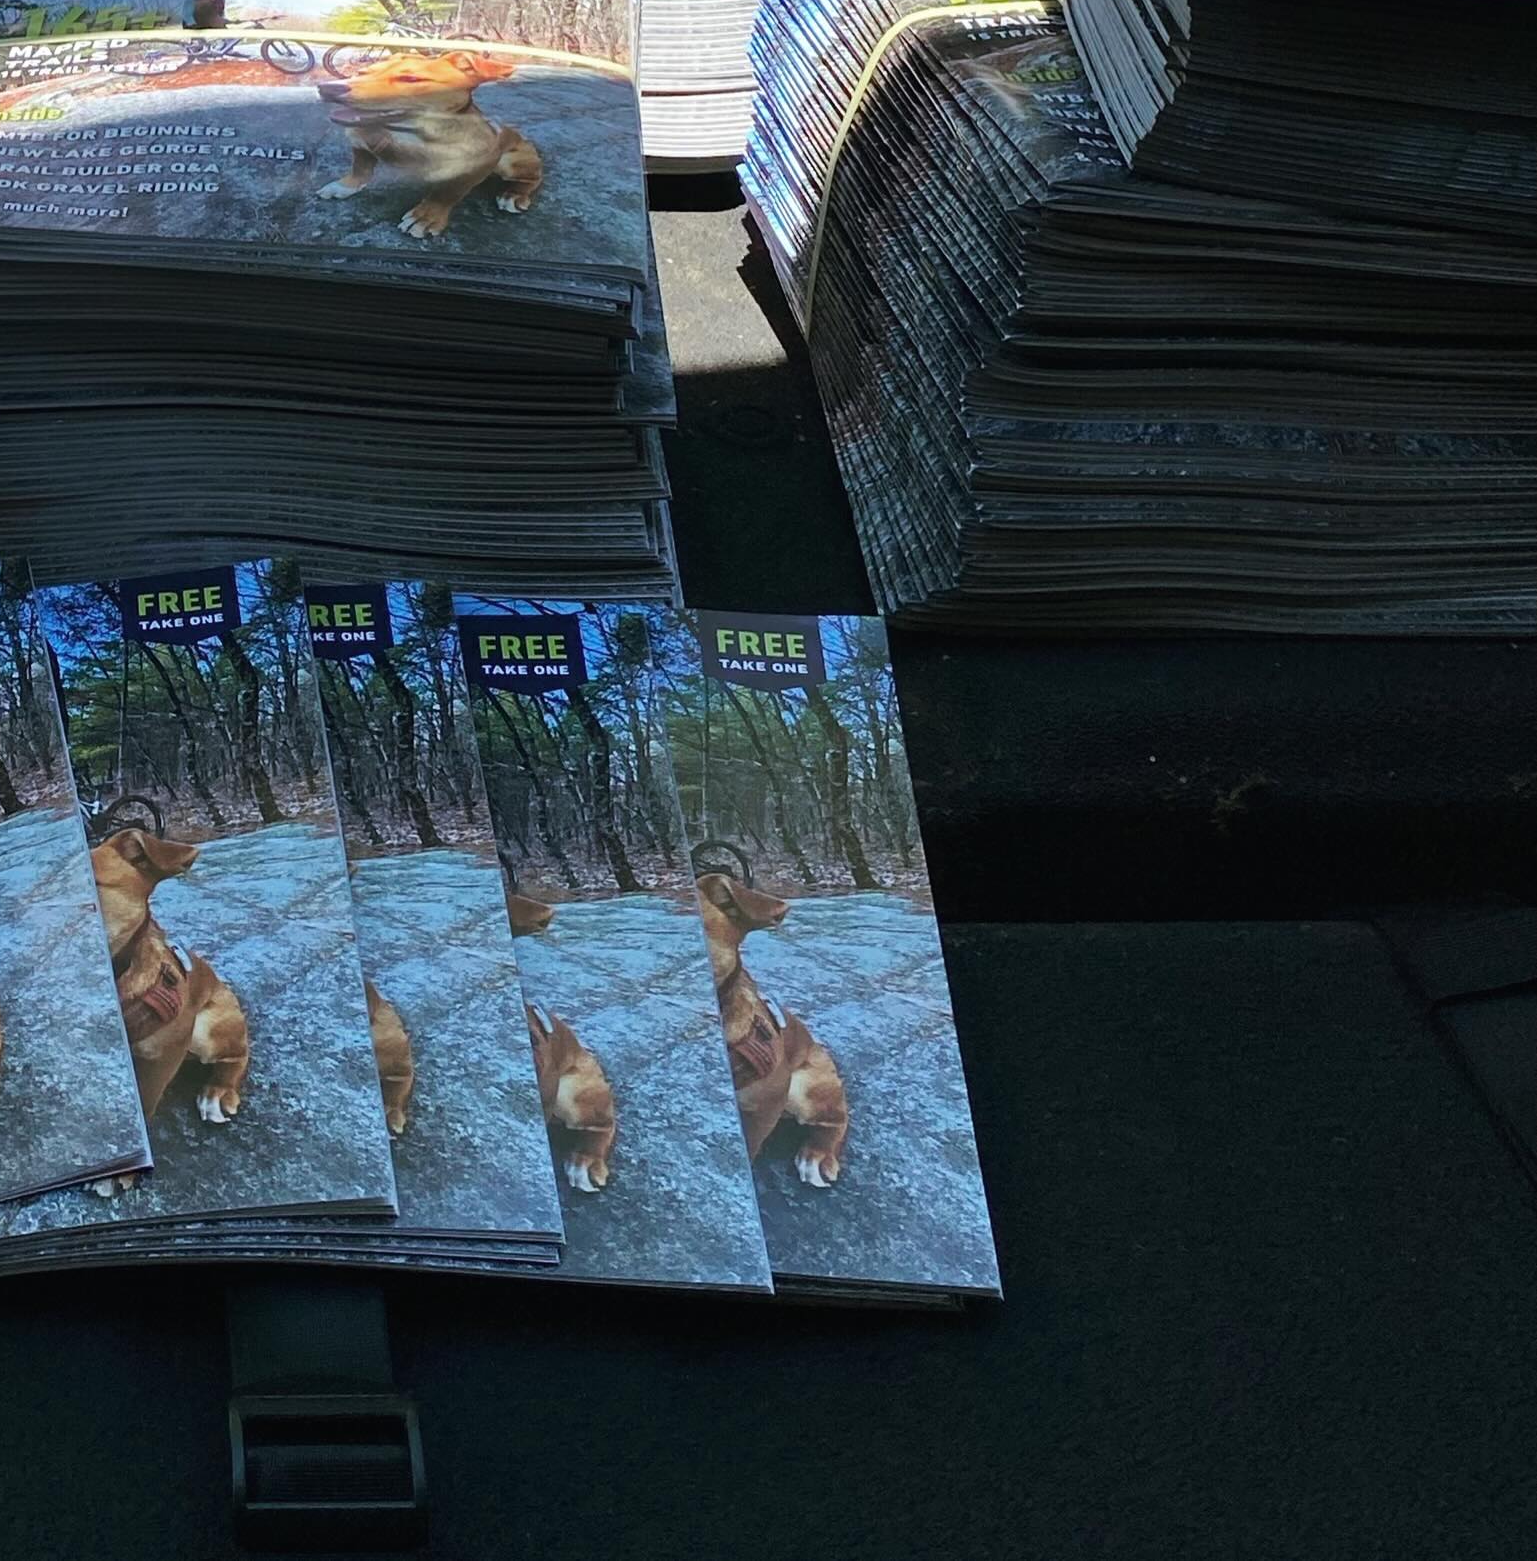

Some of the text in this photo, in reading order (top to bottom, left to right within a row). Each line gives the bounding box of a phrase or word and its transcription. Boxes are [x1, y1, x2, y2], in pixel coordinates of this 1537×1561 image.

[9, 38, 131, 60] MAPPED
[5, 51, 109, 69] TRAILS
[28, 65, 83, 77] TRAIL
[86, 61, 180, 75] SYSTEMS
[47, 129, 97, 141] FOR
[102, 126, 237, 139] BEGINNERS
[50, 146, 113, 159] LAKE
[119, 144, 212, 157] GEORGE
[219, 145, 307, 161] TRAILS
[61, 163, 163, 176] BUILDER
[170, 162, 221, 174] Q&A
[35, 181, 131, 195] GRAVEL
[137, 181, 221, 193] RIDING
[3, 200, 60, 215] much
[66, 205, 129, 219] more!
[138, 586, 225, 616] FREE
[139, 614, 225, 631] TAKE ONE
[309, 604, 375, 627] REE
[341, 631, 377, 642] ONE
[717, 629, 807, 659] FREE
[478, 635, 568, 661] FREE
[481, 664, 570, 675] TAKE ONE
[719, 658, 809, 675] TAKE ONE
